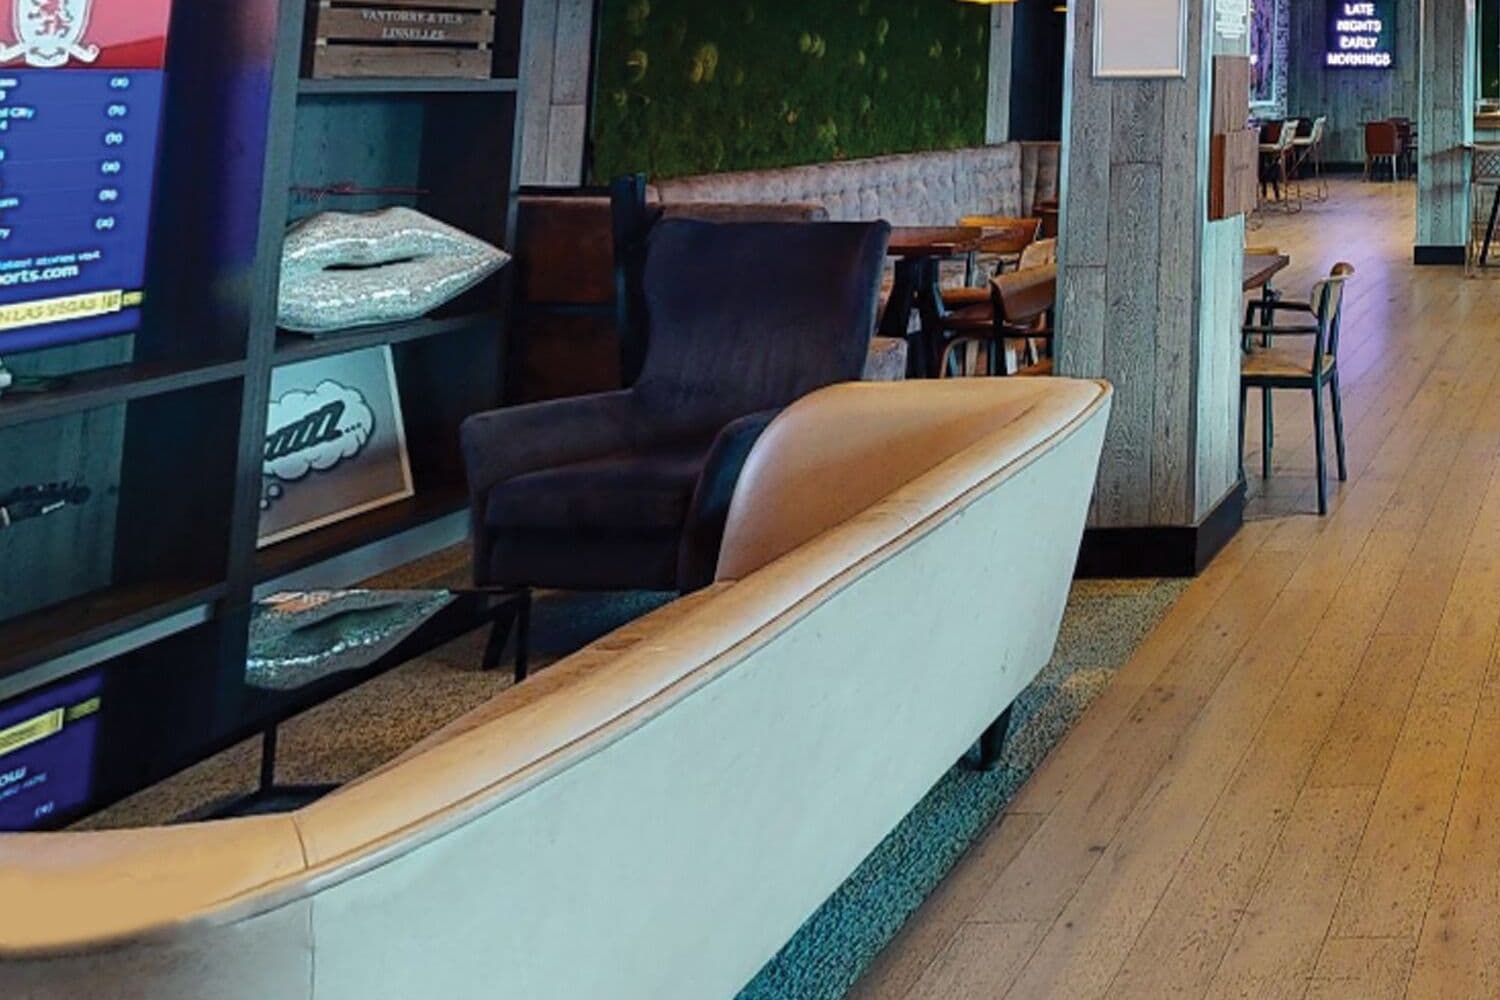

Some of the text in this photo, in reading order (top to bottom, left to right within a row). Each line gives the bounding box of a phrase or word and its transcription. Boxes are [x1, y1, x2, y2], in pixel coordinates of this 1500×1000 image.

[1344, 3, 1375, 16] LATE
[1336, 20, 1382, 33] NIGHTS
[1339, 35, 1378, 49] EARLY
[1326, 52, 1392, 67] MORNINGS
